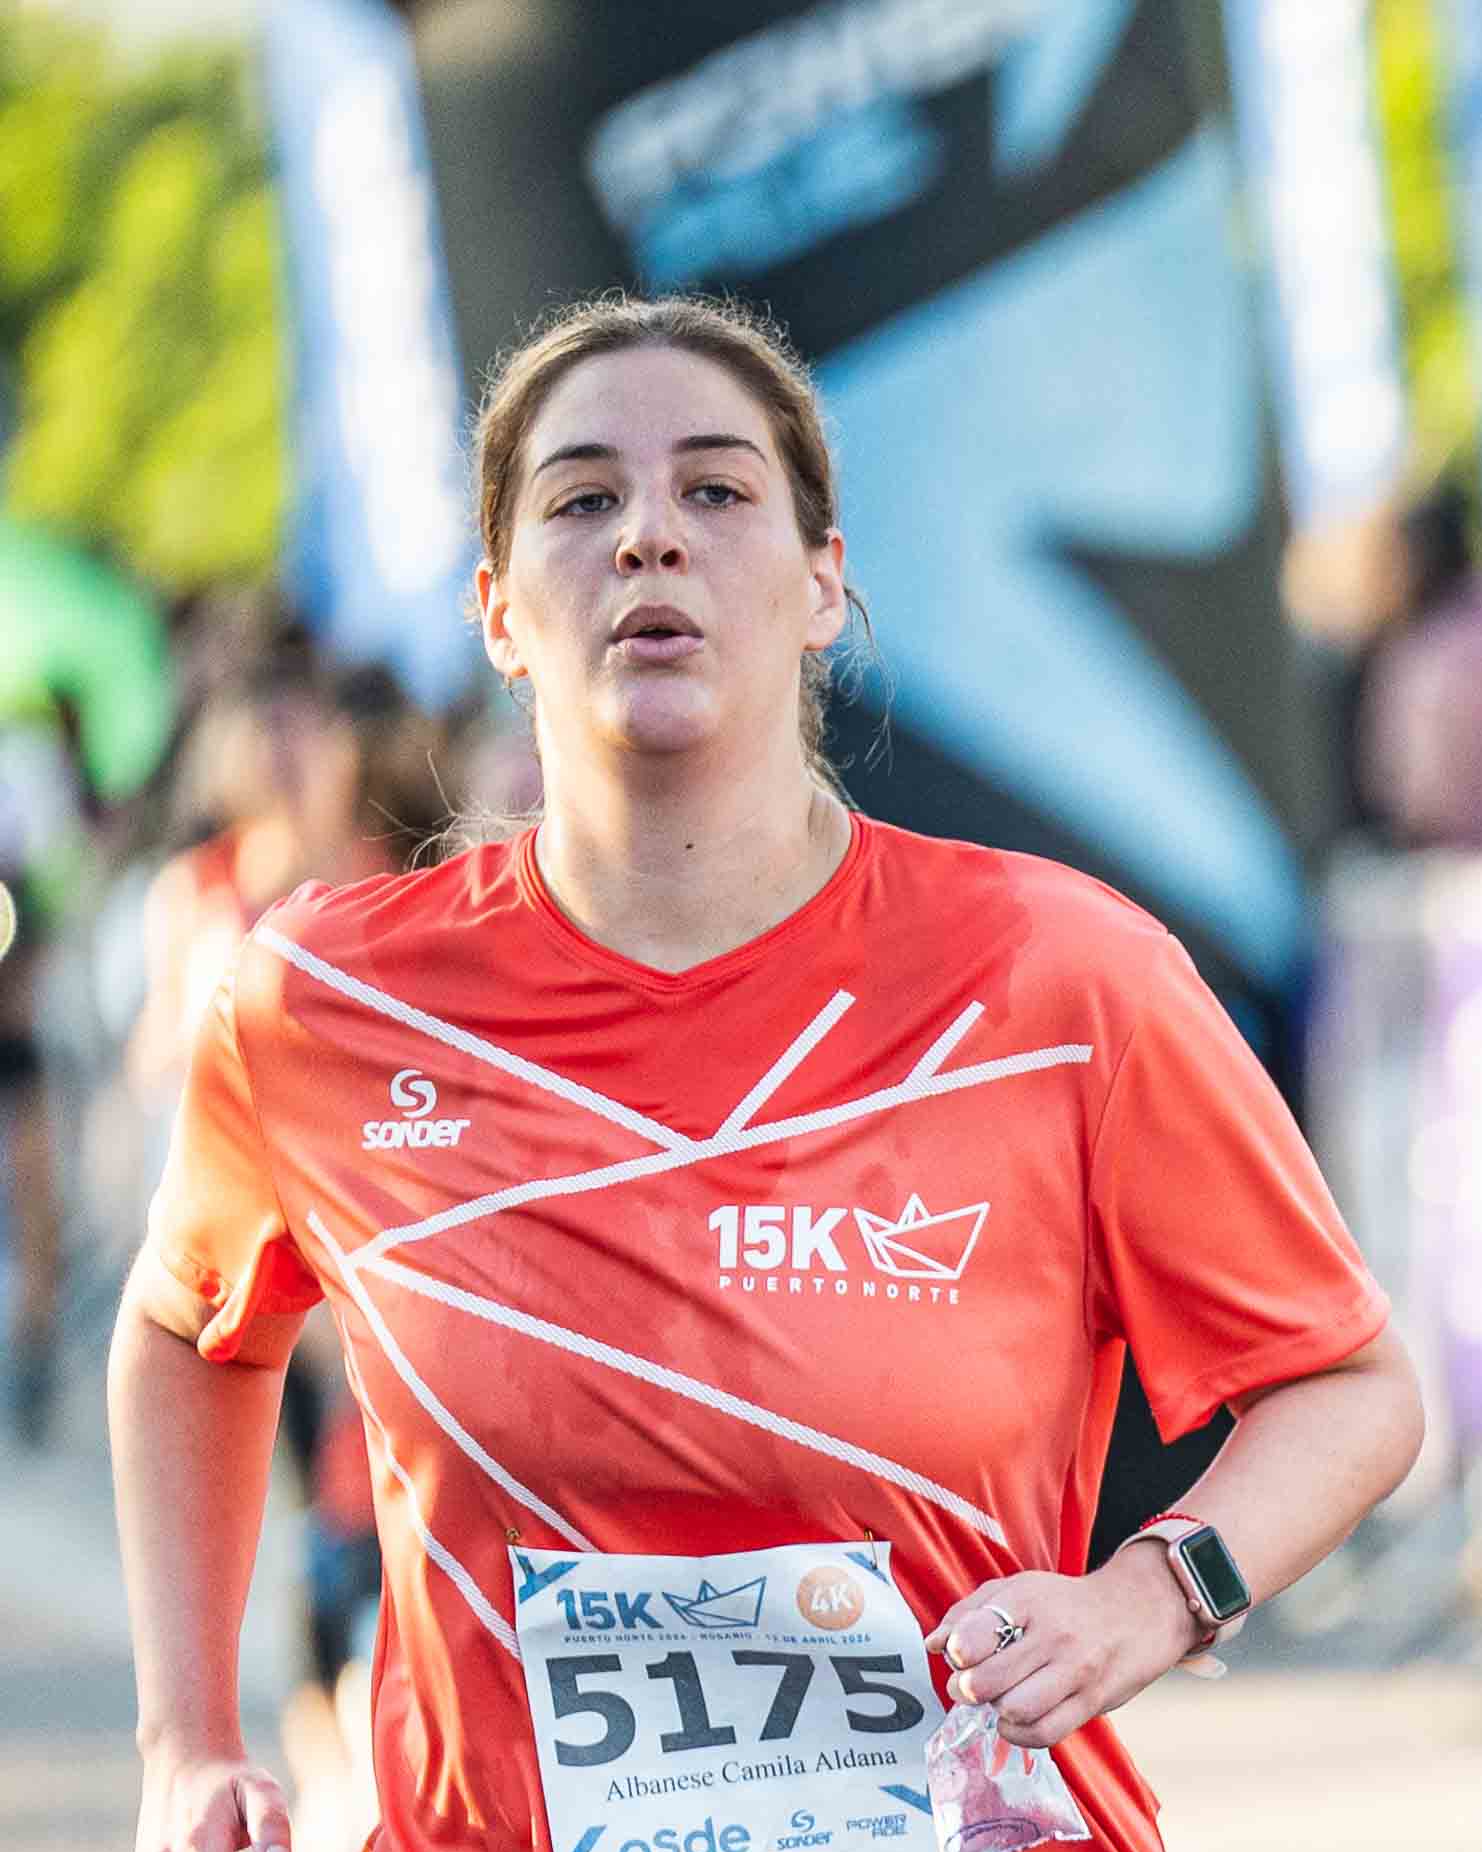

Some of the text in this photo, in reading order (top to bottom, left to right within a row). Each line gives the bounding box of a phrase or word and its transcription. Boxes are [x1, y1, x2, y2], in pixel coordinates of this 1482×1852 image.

[708, 1204, 848, 1271] 15K
[719, 1277, 960, 1305] PUERTO NORTE
[556, 1589, 664, 1630] 15K
[810, 1583, 855, 1614] 4K
[546, 1650, 926, 1767] 5175
[605, 1747, 897, 1801] Albanese Camila Aldana
